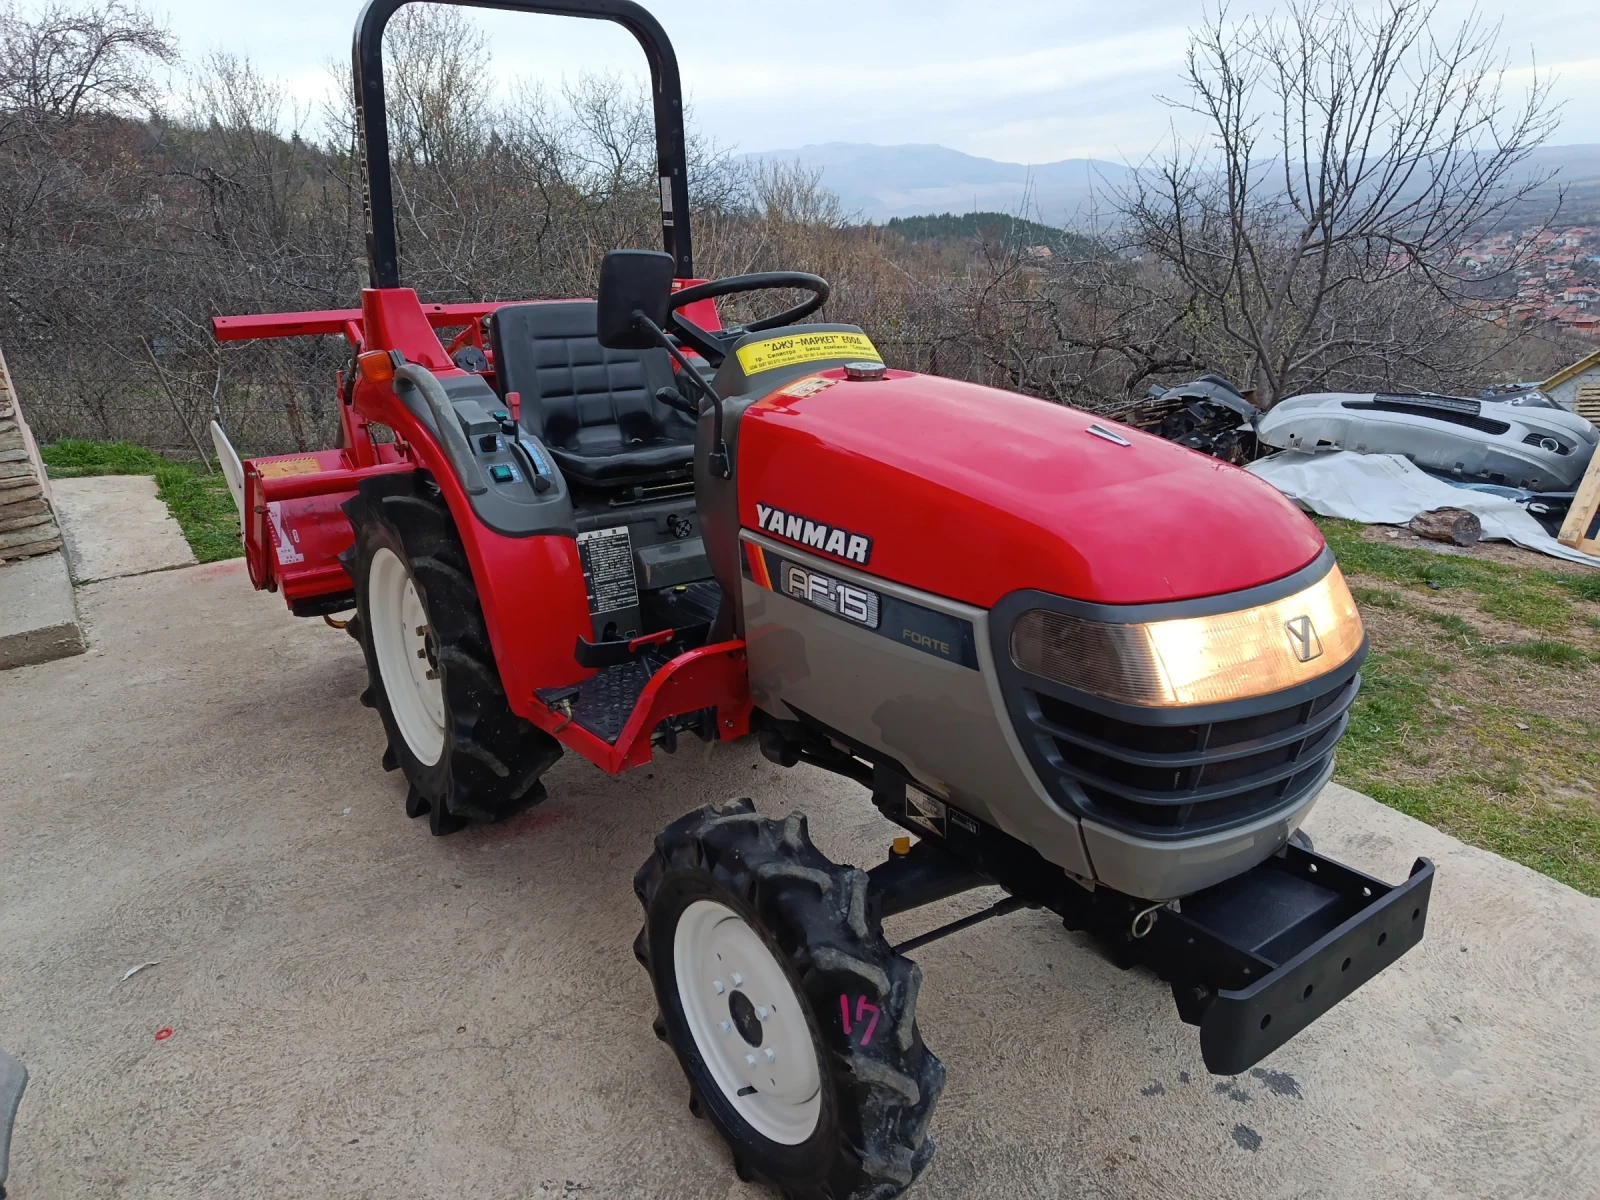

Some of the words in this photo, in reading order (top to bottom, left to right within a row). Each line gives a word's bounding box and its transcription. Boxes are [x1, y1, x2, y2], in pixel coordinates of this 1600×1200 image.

[841, 335, 862, 345] ЕООД
[767, 349, 796, 359] Силистра
[756, 502, 872, 564] YANMAR
[903, 628, 950, 655] FORTE
